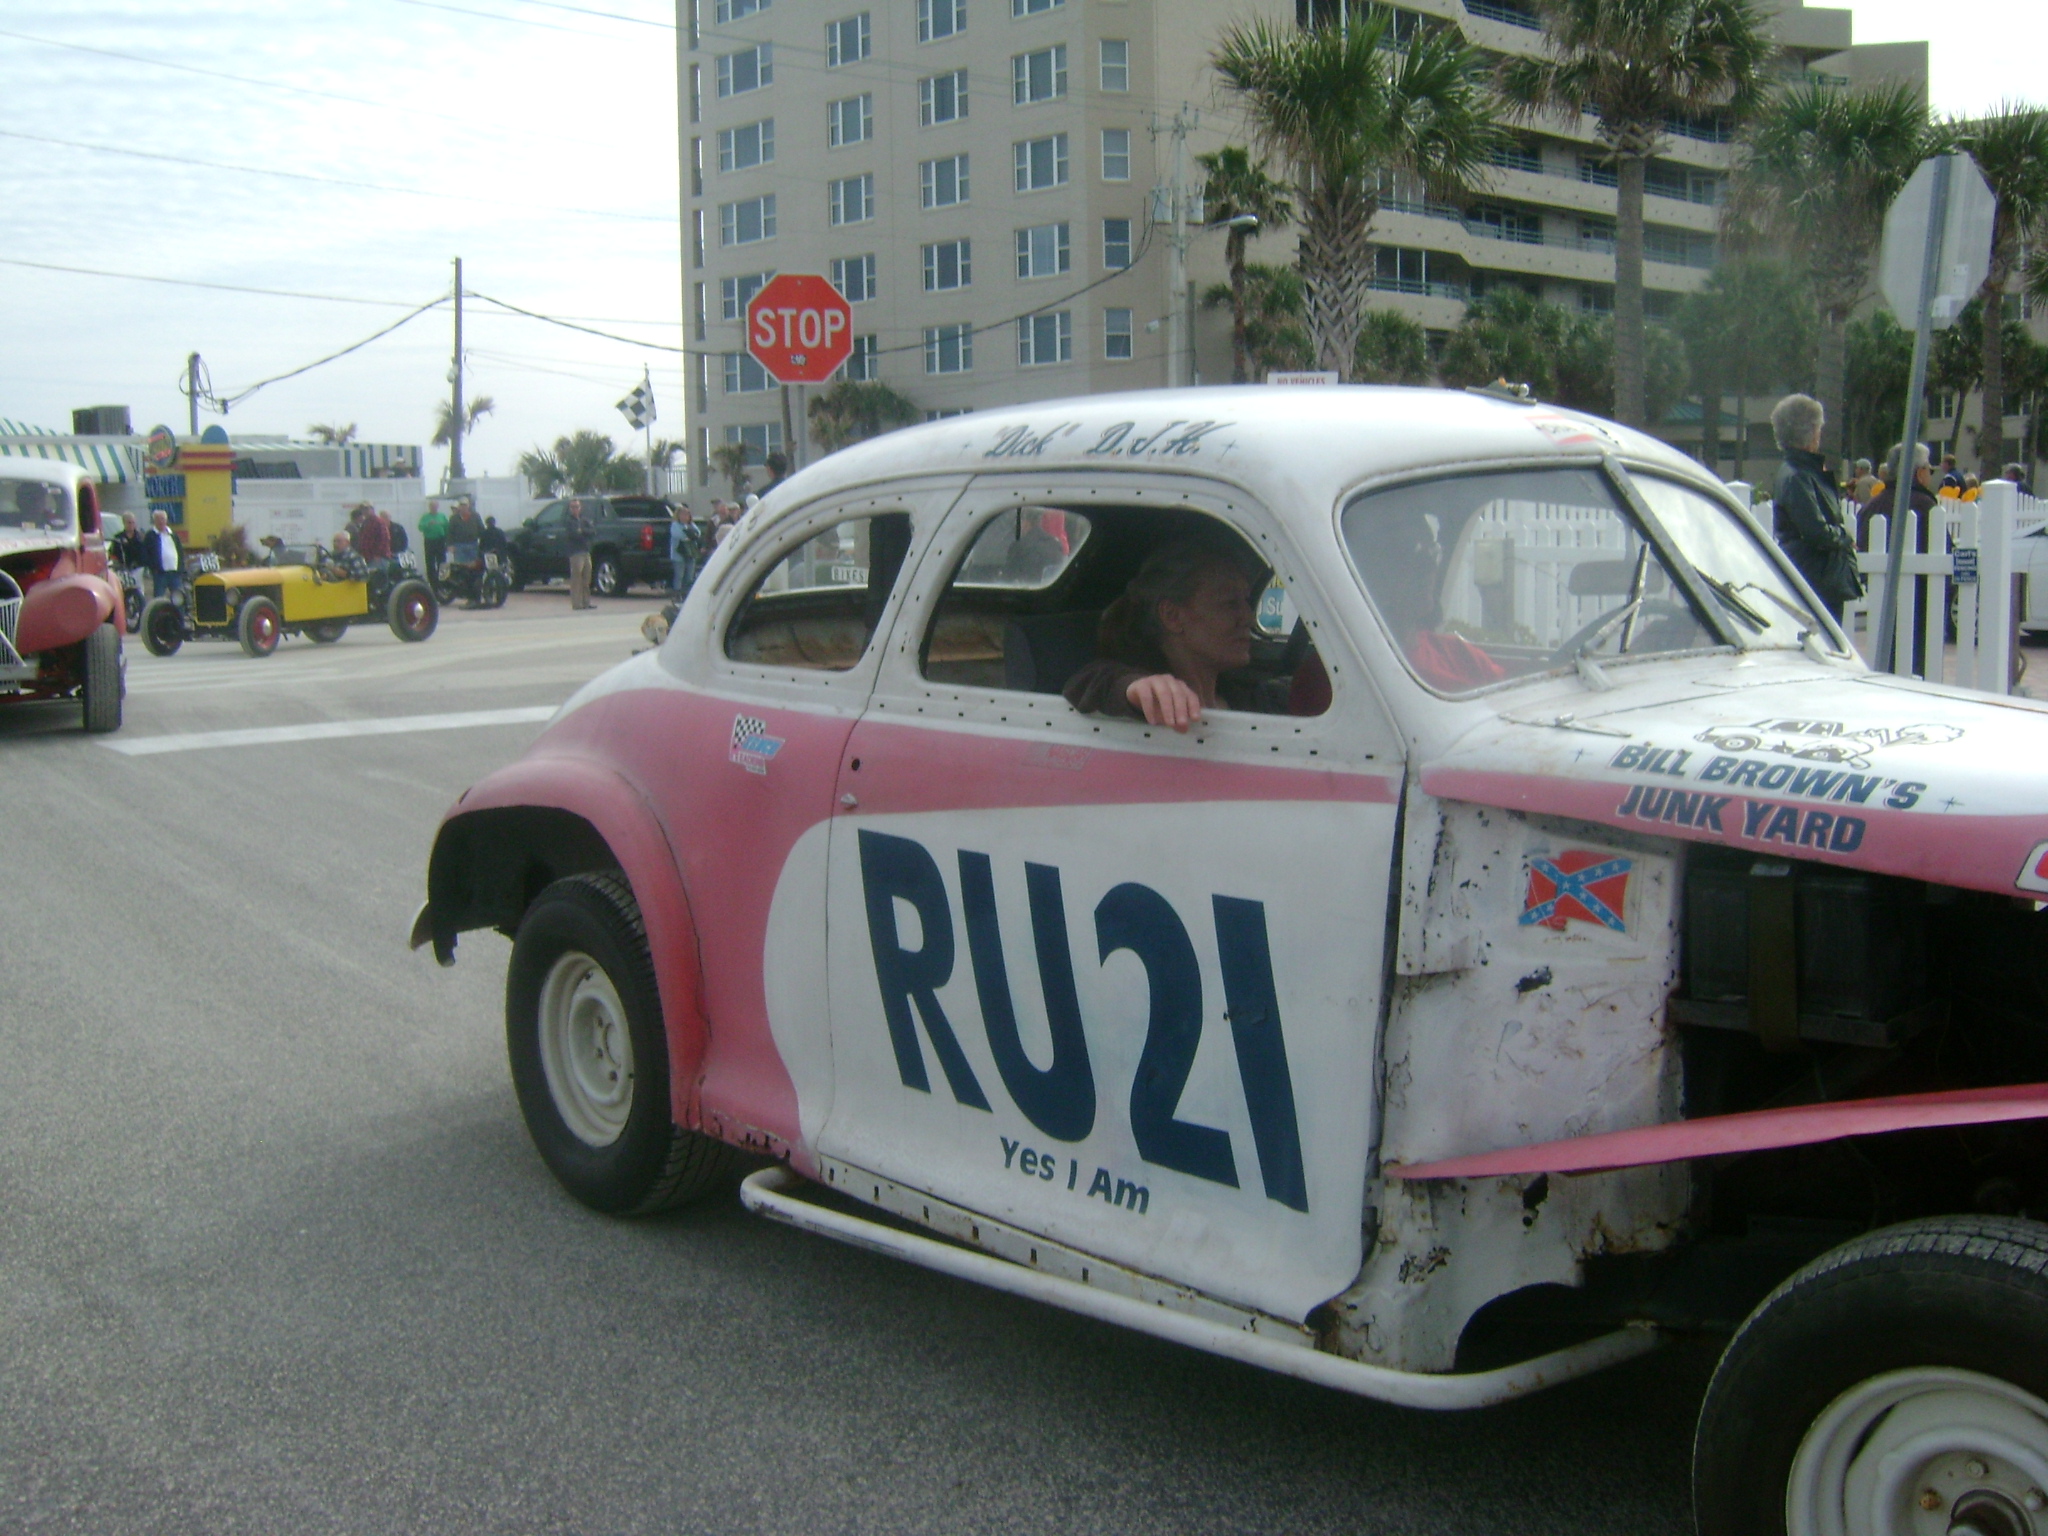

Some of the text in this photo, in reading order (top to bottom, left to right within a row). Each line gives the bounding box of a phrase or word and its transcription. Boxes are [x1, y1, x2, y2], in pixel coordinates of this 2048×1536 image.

[755, 308, 845, 348] STOP
[1608, 745, 1927, 810] BILL BROWN'S
[1616, 784, 1867, 855] JUNK YARD
[1000, 1135, 1150, 1215] Yes I Am
